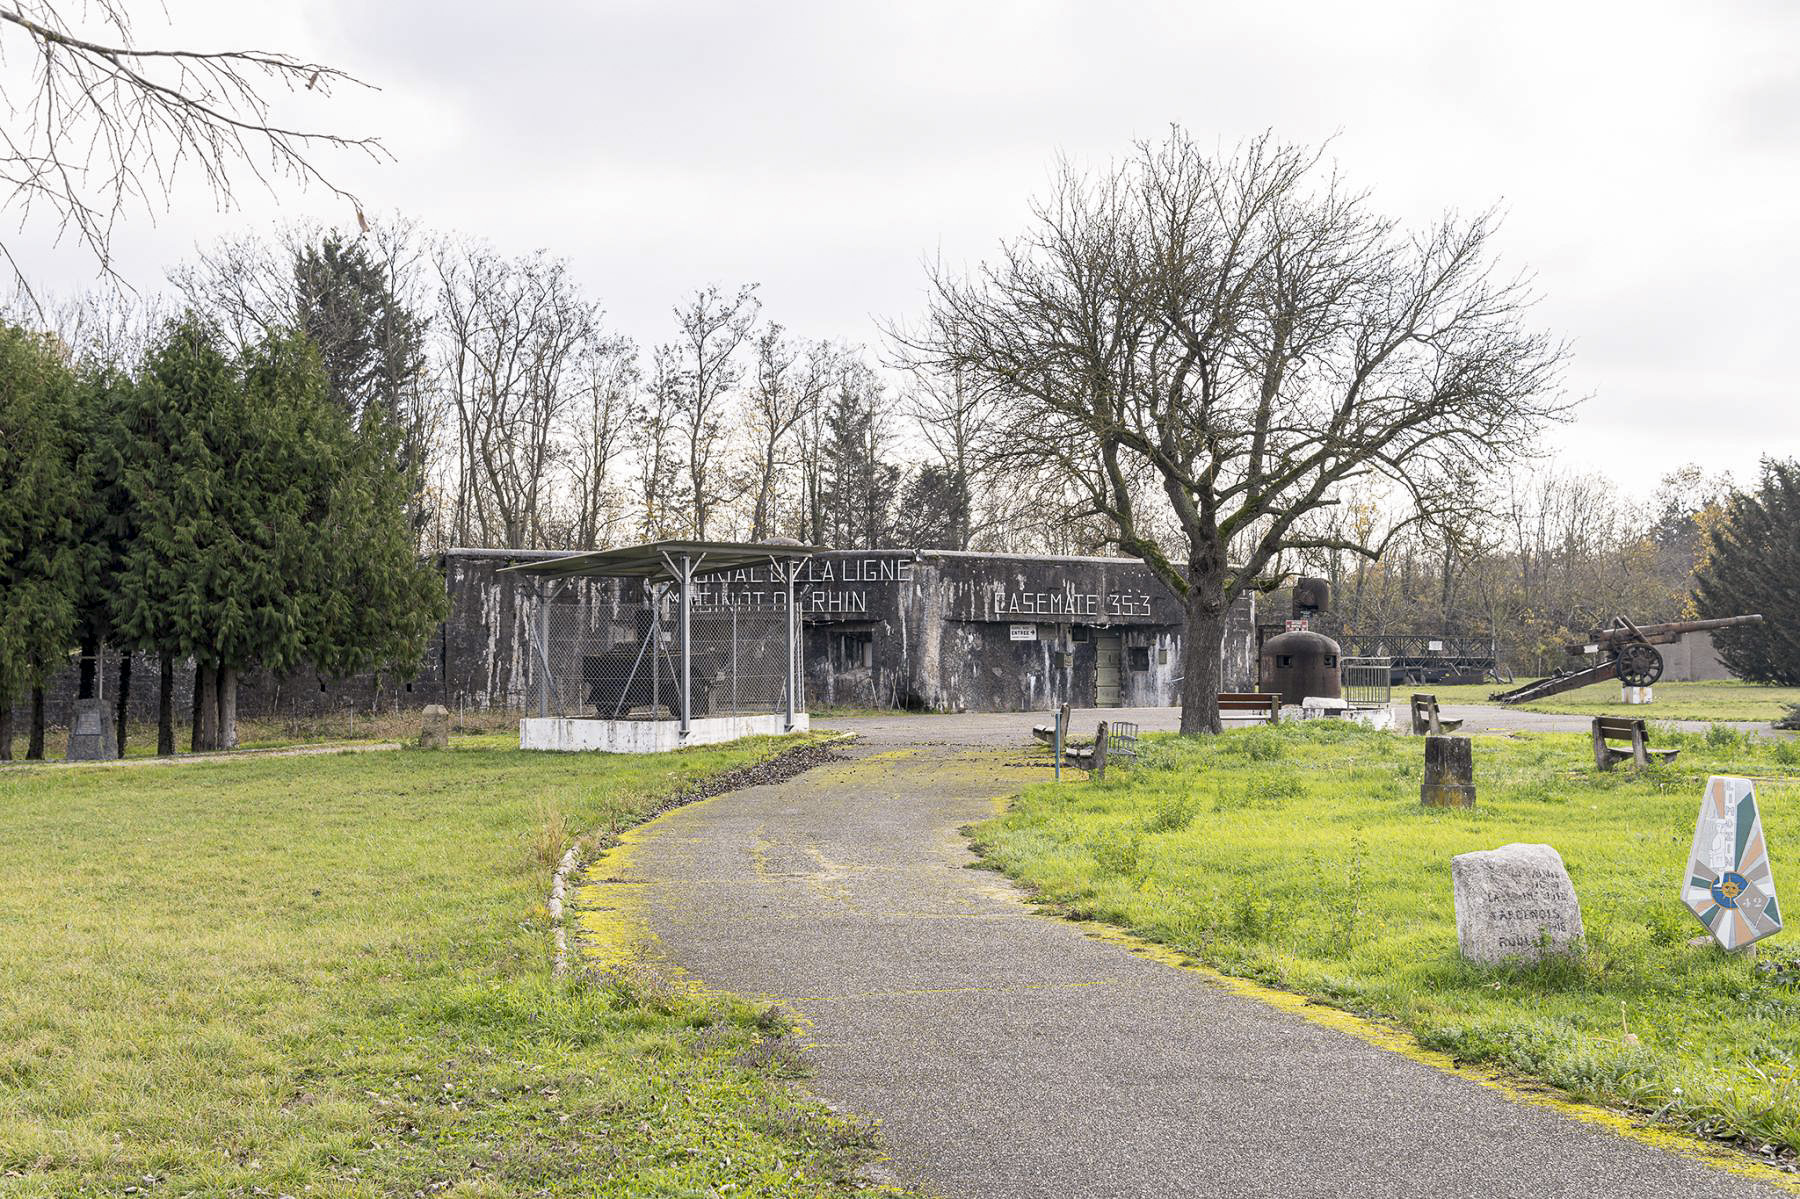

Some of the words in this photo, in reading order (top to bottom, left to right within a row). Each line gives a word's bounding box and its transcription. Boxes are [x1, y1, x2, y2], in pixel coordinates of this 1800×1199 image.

[809, 559, 835, 582] LA
[843, 559, 911, 582] LIGNE
[812, 591, 866, 613] RHIN
[994, 592, 1099, 615] CASEMATE
[1109, 594, 1151, 616] 35-3
